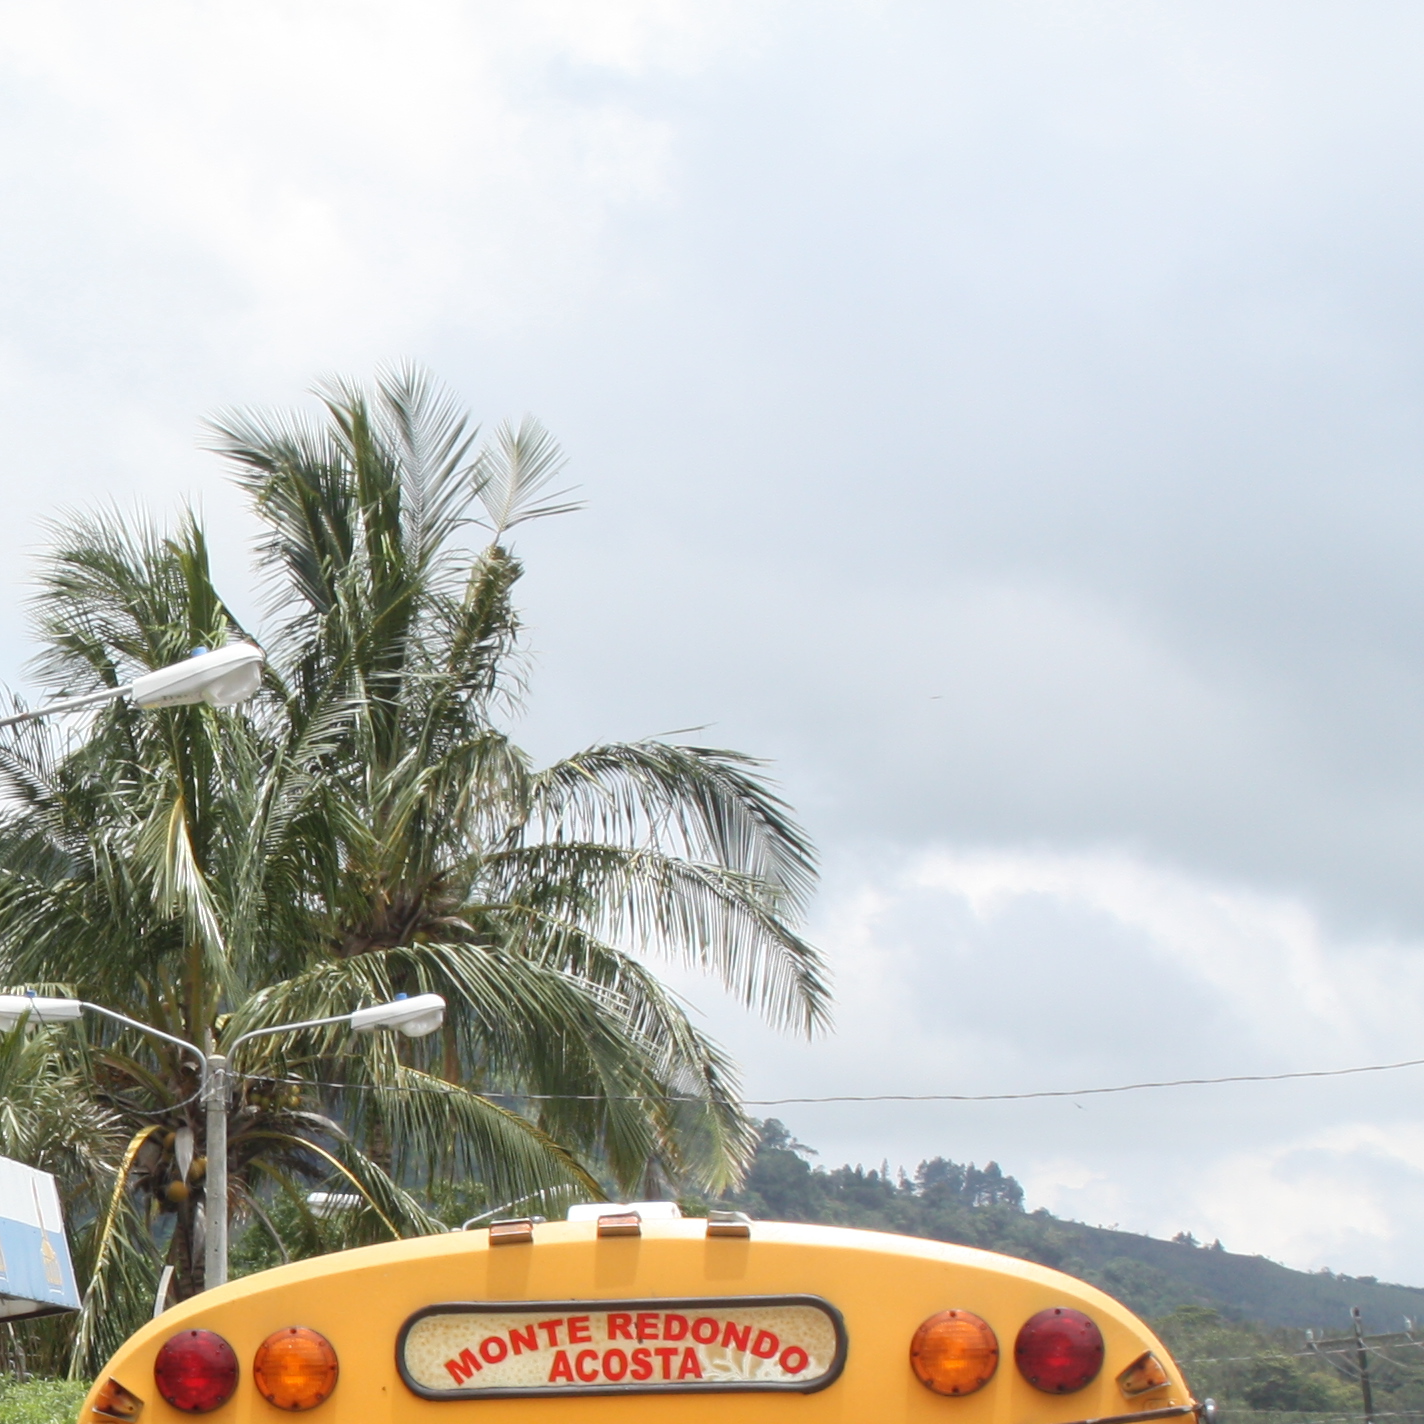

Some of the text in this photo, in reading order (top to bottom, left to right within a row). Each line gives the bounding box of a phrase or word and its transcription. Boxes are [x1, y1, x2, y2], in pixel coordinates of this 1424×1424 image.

[442, 1312, 811, 1387] MONTE REDONDO
[548, 1346, 703, 1384] ACOSTA
